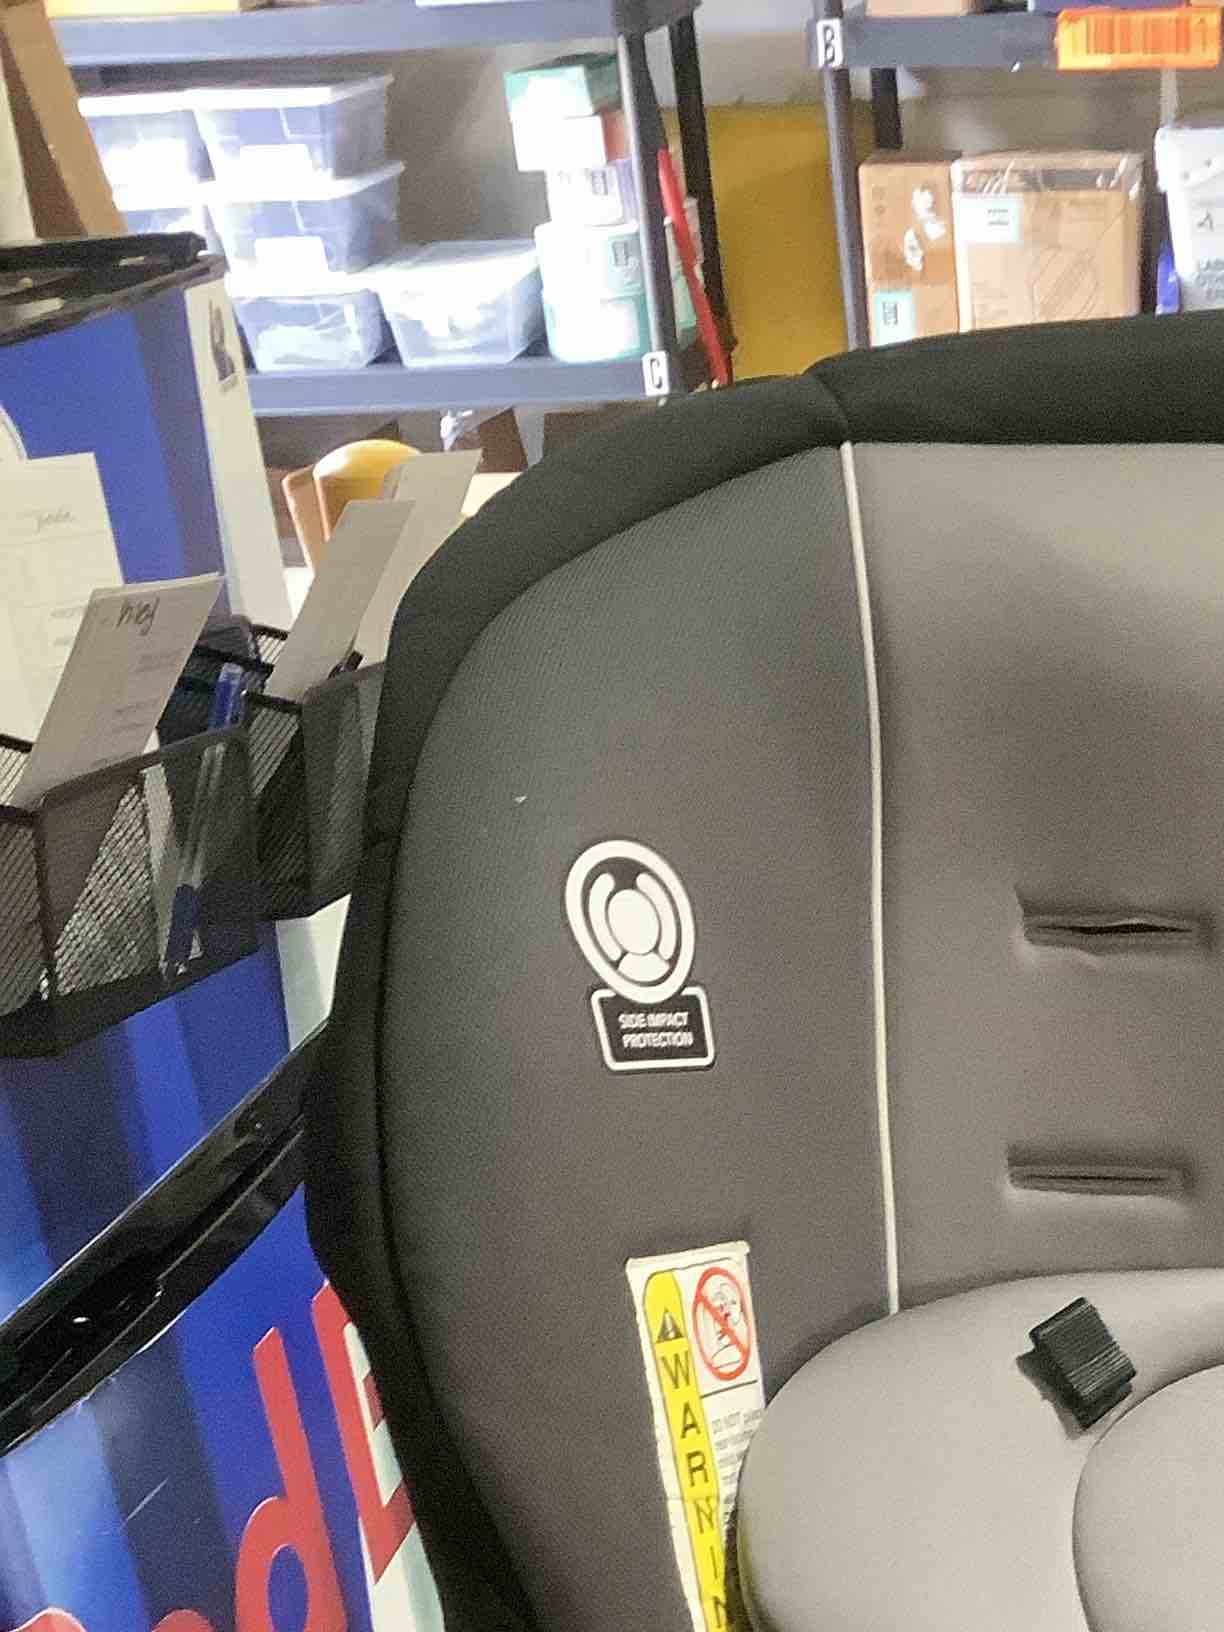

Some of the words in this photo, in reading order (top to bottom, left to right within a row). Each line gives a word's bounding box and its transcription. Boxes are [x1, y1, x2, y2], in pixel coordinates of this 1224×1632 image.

[618, 1013, 646, 1028] SIDE
[647, 1012, 689, 1026] IMPACT
[623, 1032, 694, 1048] PROTECTION
